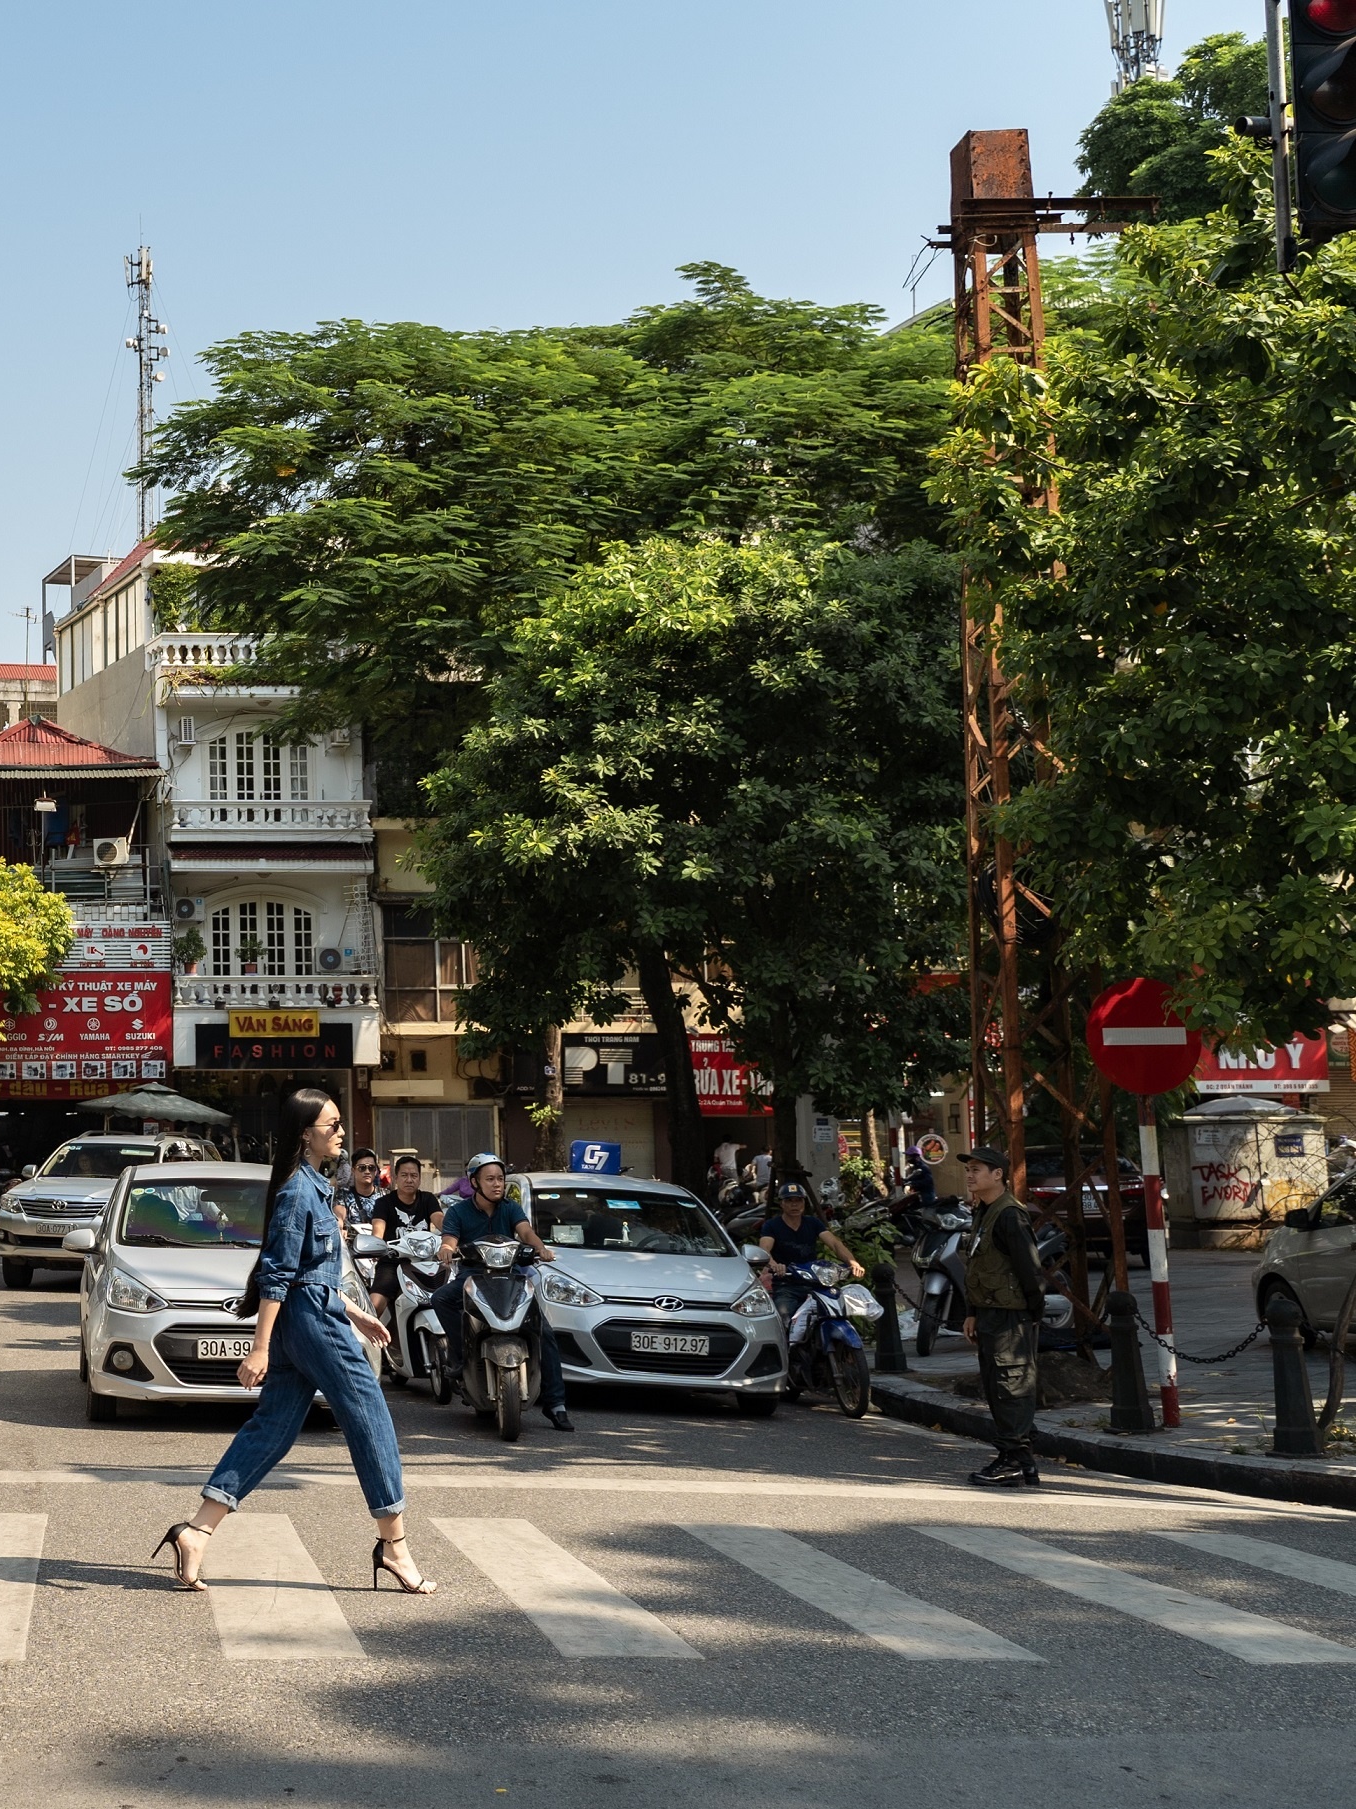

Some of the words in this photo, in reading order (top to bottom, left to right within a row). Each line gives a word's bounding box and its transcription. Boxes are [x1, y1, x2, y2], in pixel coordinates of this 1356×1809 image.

[77, 980, 113, 992] THUẬT
[117, 982, 132, 991] XE
[134, 980, 157, 991] MÁY
[63, 997, 98, 1012] XE
[104, 991, 143, 1012] SỐ
[271, 1015, 314, 1032] SÁNG
[80, 1033, 111, 1041] YAMAHA
[125, 1032, 156, 1040] SUZUKI
[214, 1044, 337, 1059] FASHION
[691, 1040, 720, 1053] TRUNG
[55, 1051, 78, 1060] CHÍNH
[564, 1046, 633, 1085] PT
[9, 1080, 48, 1096] dầu
[69, 1079, 110, 1096] Rửa
[722, 1069, 741, 1096] XE
[583, 1144, 610, 1171] G7
[200, 1340, 251, 1357] 30A-99
[634, 1335, 706, 1353] 30E-912.97
